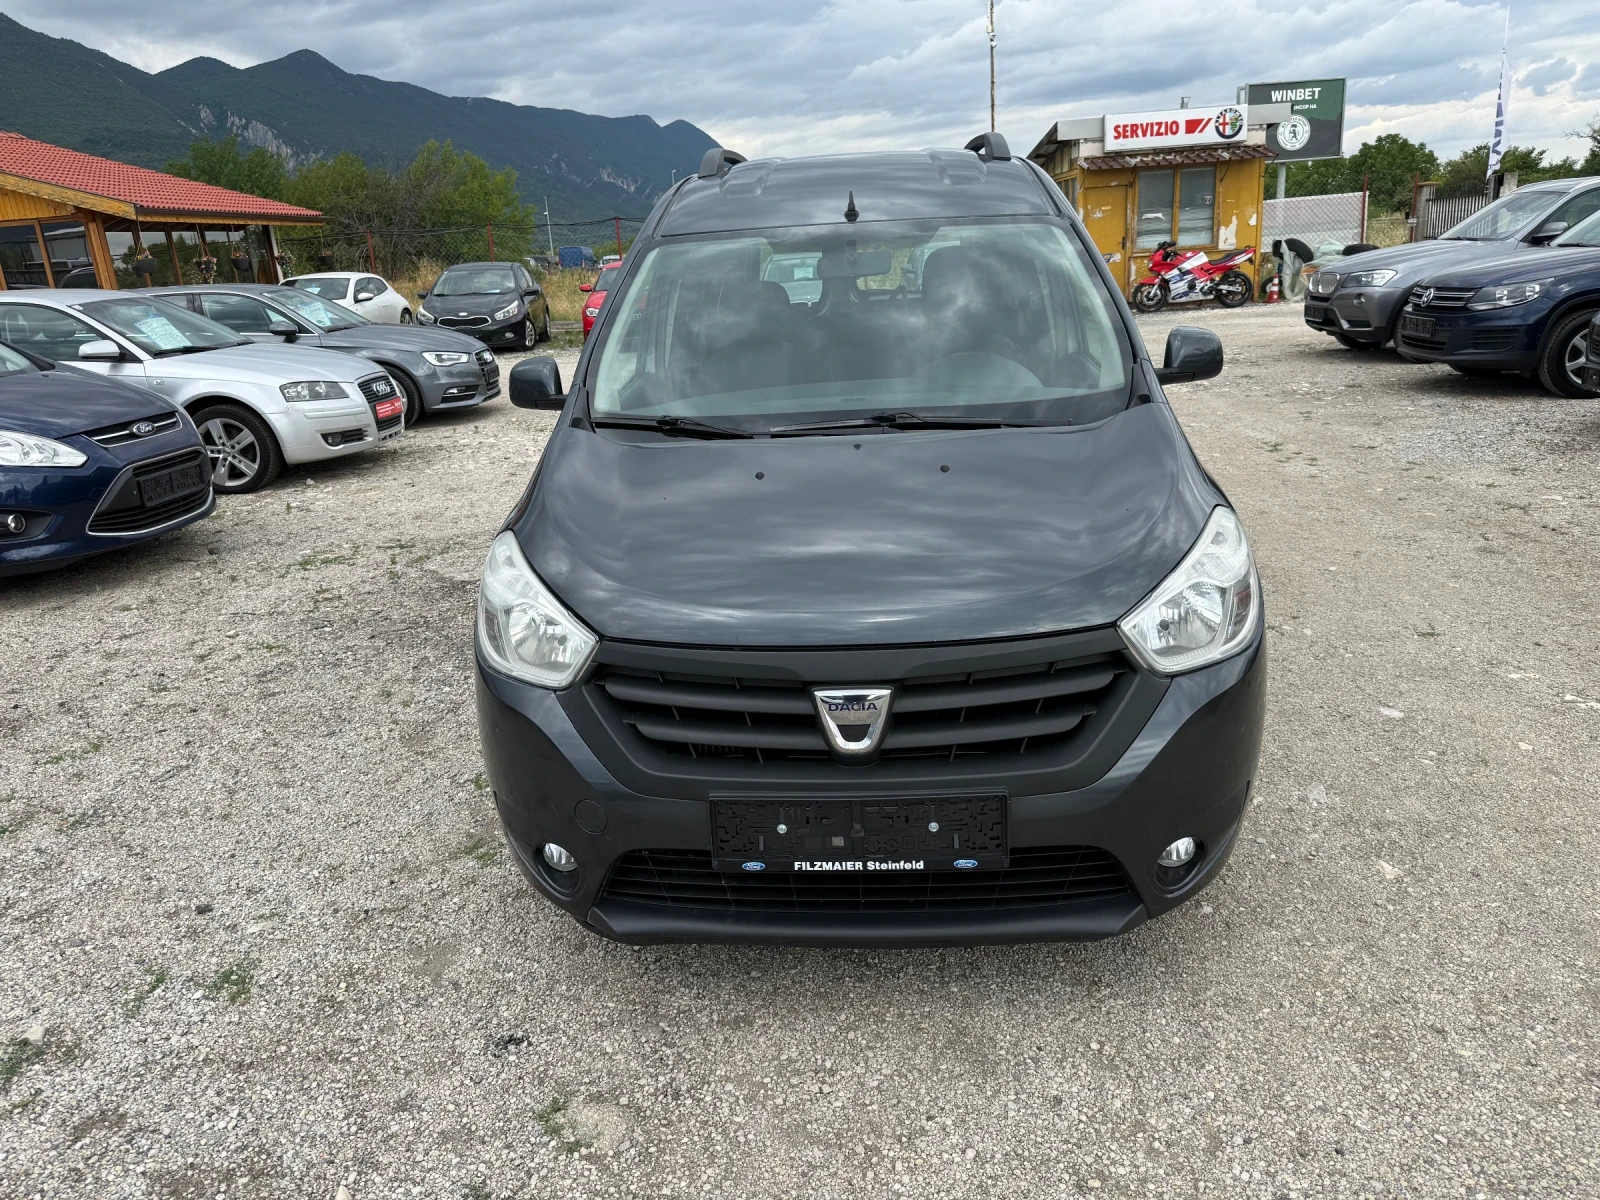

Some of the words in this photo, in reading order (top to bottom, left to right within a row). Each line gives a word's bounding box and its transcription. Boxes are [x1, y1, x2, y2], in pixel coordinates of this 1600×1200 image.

[1271, 87, 1322, 103] WINBET
[1113, 119, 1180, 140] SERVIZIO
[828, 702, 878, 712] DACIA
[794, 861, 863, 871] FILZMAIER
[866, 860, 924, 871] Steinfeld
